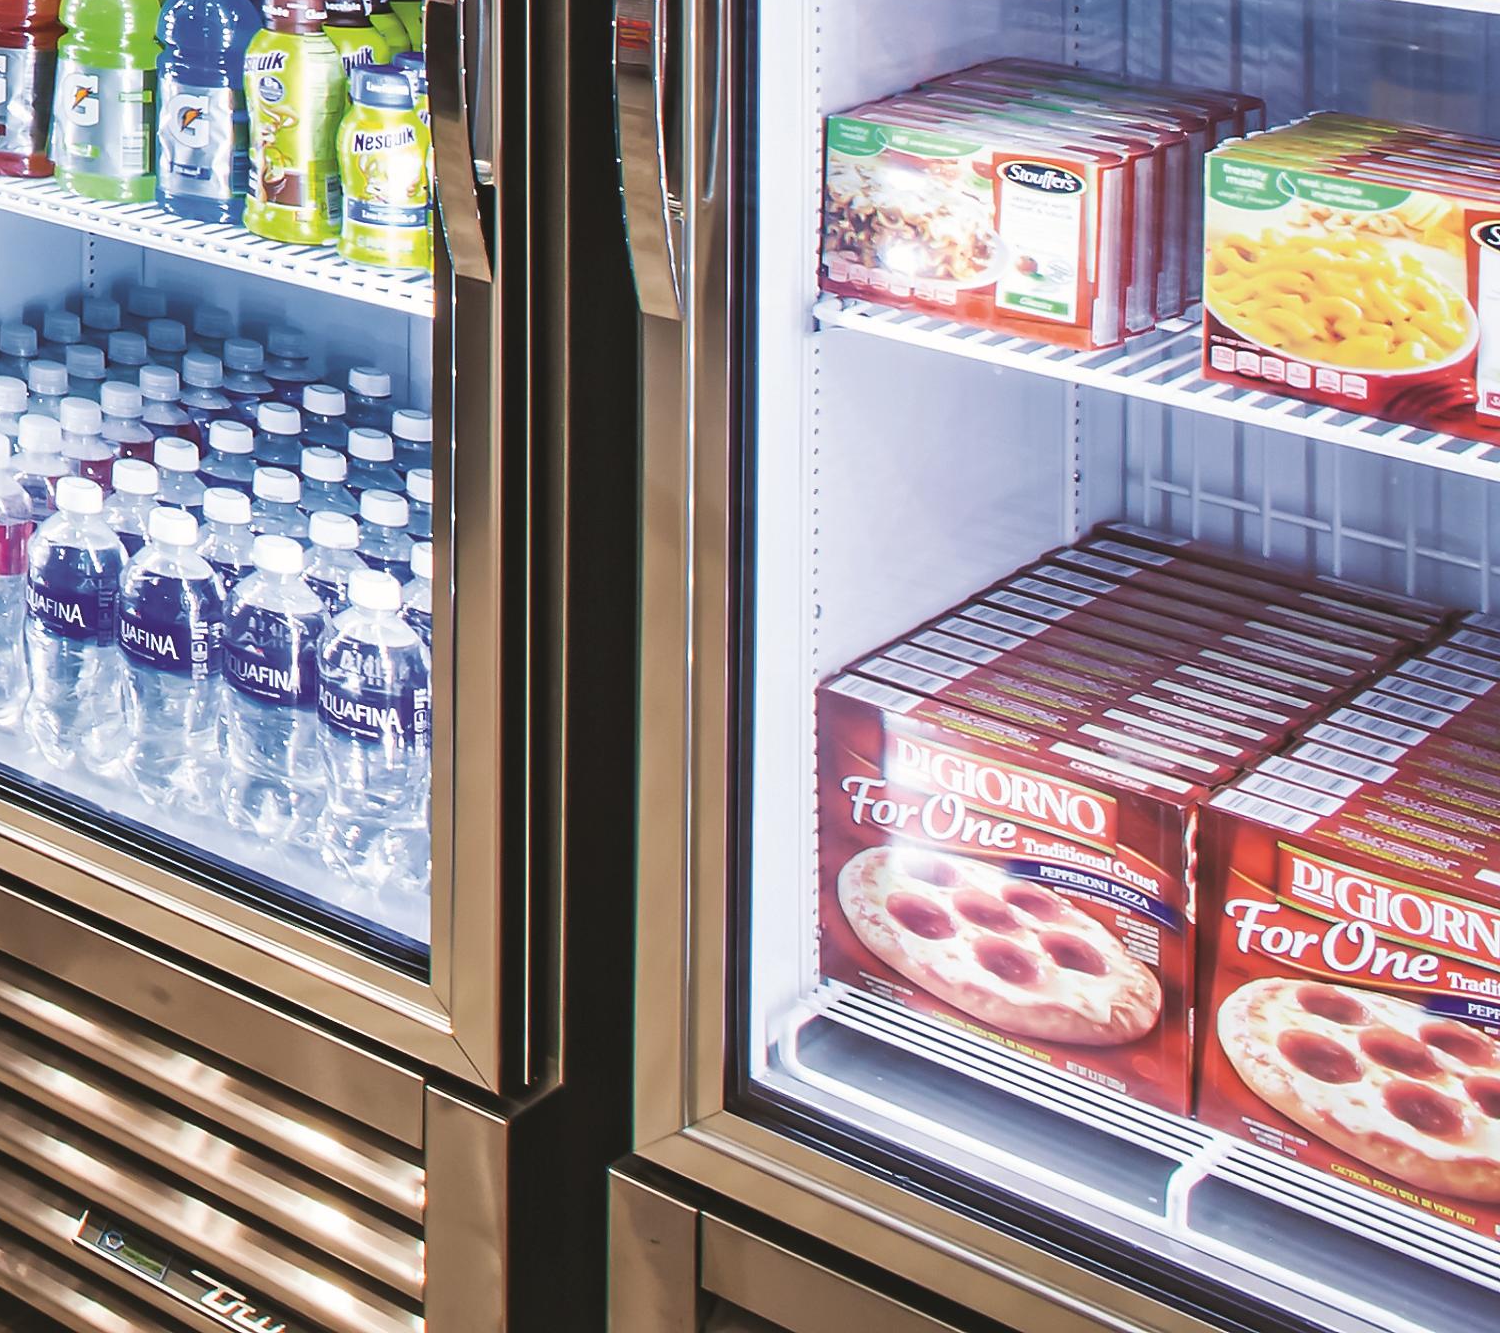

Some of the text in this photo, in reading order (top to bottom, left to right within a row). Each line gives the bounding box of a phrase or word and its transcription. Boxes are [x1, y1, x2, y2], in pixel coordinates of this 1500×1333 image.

[1006, 163, 1077, 193] Stouffer's
[842, 774, 1018, 850] For One
[1021, 837, 1162, 897] Traditional Crust
[1038, 862, 1151, 912] PEPPERONI PIZZA
[1224, 897, 1319, 960] For
[1321, 919, 1440, 984] One
